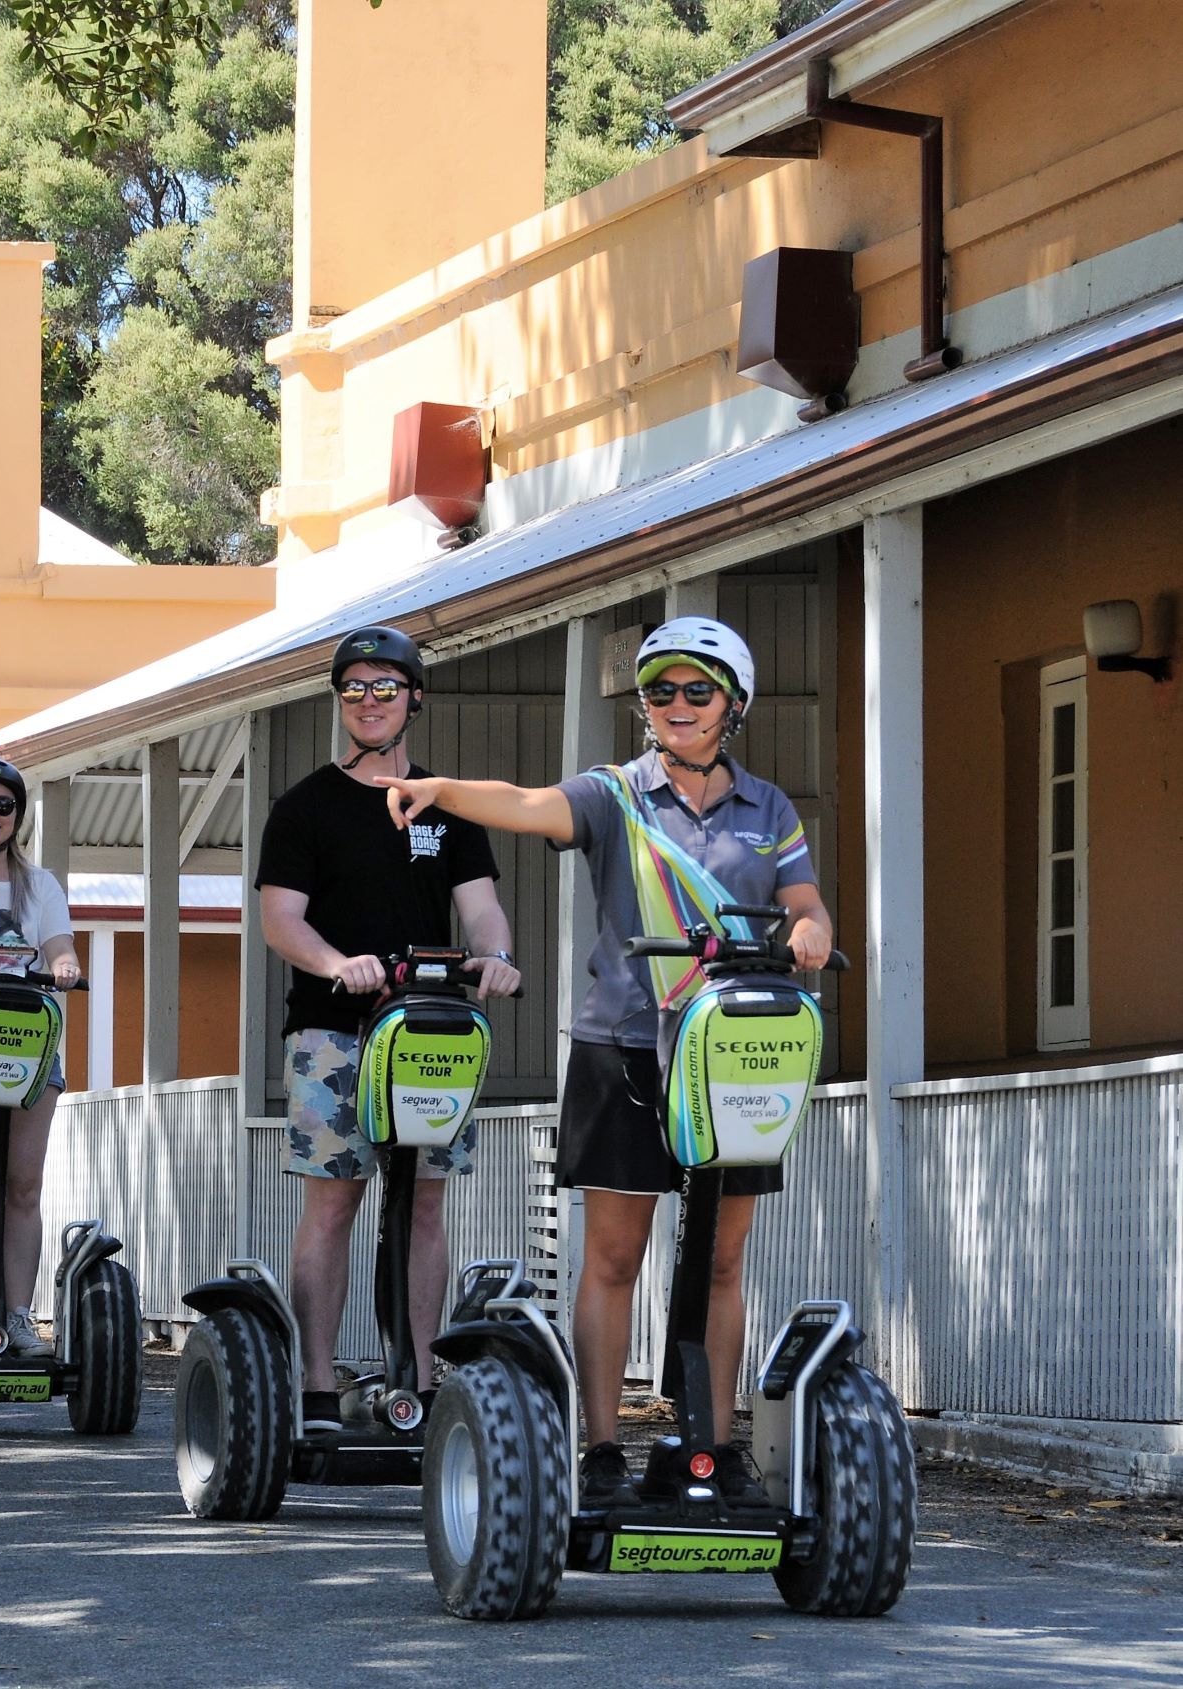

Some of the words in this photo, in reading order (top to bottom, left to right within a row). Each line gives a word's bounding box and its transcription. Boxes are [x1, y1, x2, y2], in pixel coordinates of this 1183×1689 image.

[408, 825, 433, 837] GAGE
[410, 836, 440, 851] ROADS
[714, 1040, 809, 1053] SEGWAY
[397, 1052, 477, 1064] SEGWAY
[740, 1057, 779, 1070] TOUR
[418, 1066, 452, 1077] TOUR
[375, 1038, 385, 1122] segtours.com.au
[689, 1031, 704, 1136] segtours.com.au
[401, 1096, 443, 1107] segway
[722, 1095, 771, 1109] segway
[416, 1107, 435, 1115] tours
[740, 1108, 764, 1118] tours
[616, 1545, 776, 1564] segtours.com.au
